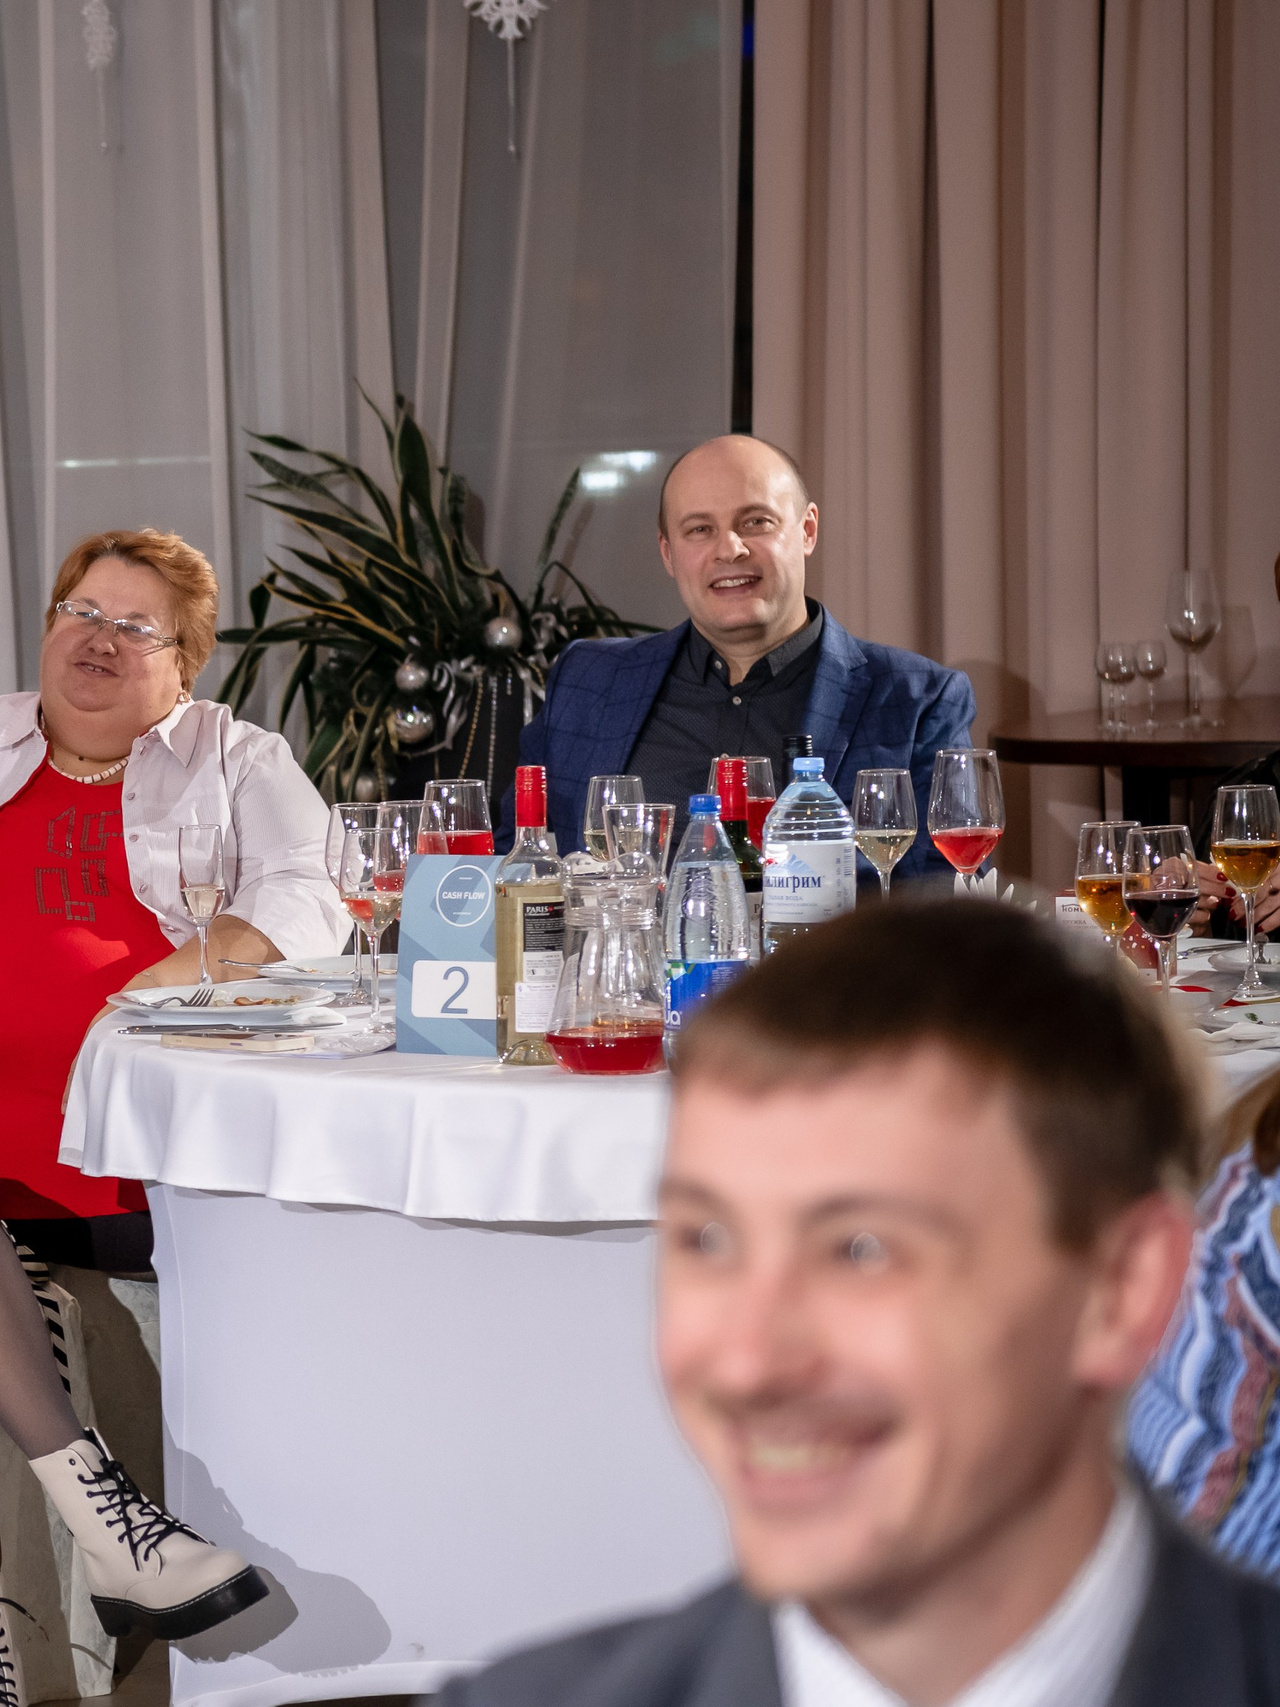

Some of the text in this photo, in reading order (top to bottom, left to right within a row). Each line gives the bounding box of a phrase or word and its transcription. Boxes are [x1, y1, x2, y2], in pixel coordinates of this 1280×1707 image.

[764, 874, 822, 893] илигрим
[442, 891, 485, 900] CASH FLOW
[440, 965, 470, 1015] 2
